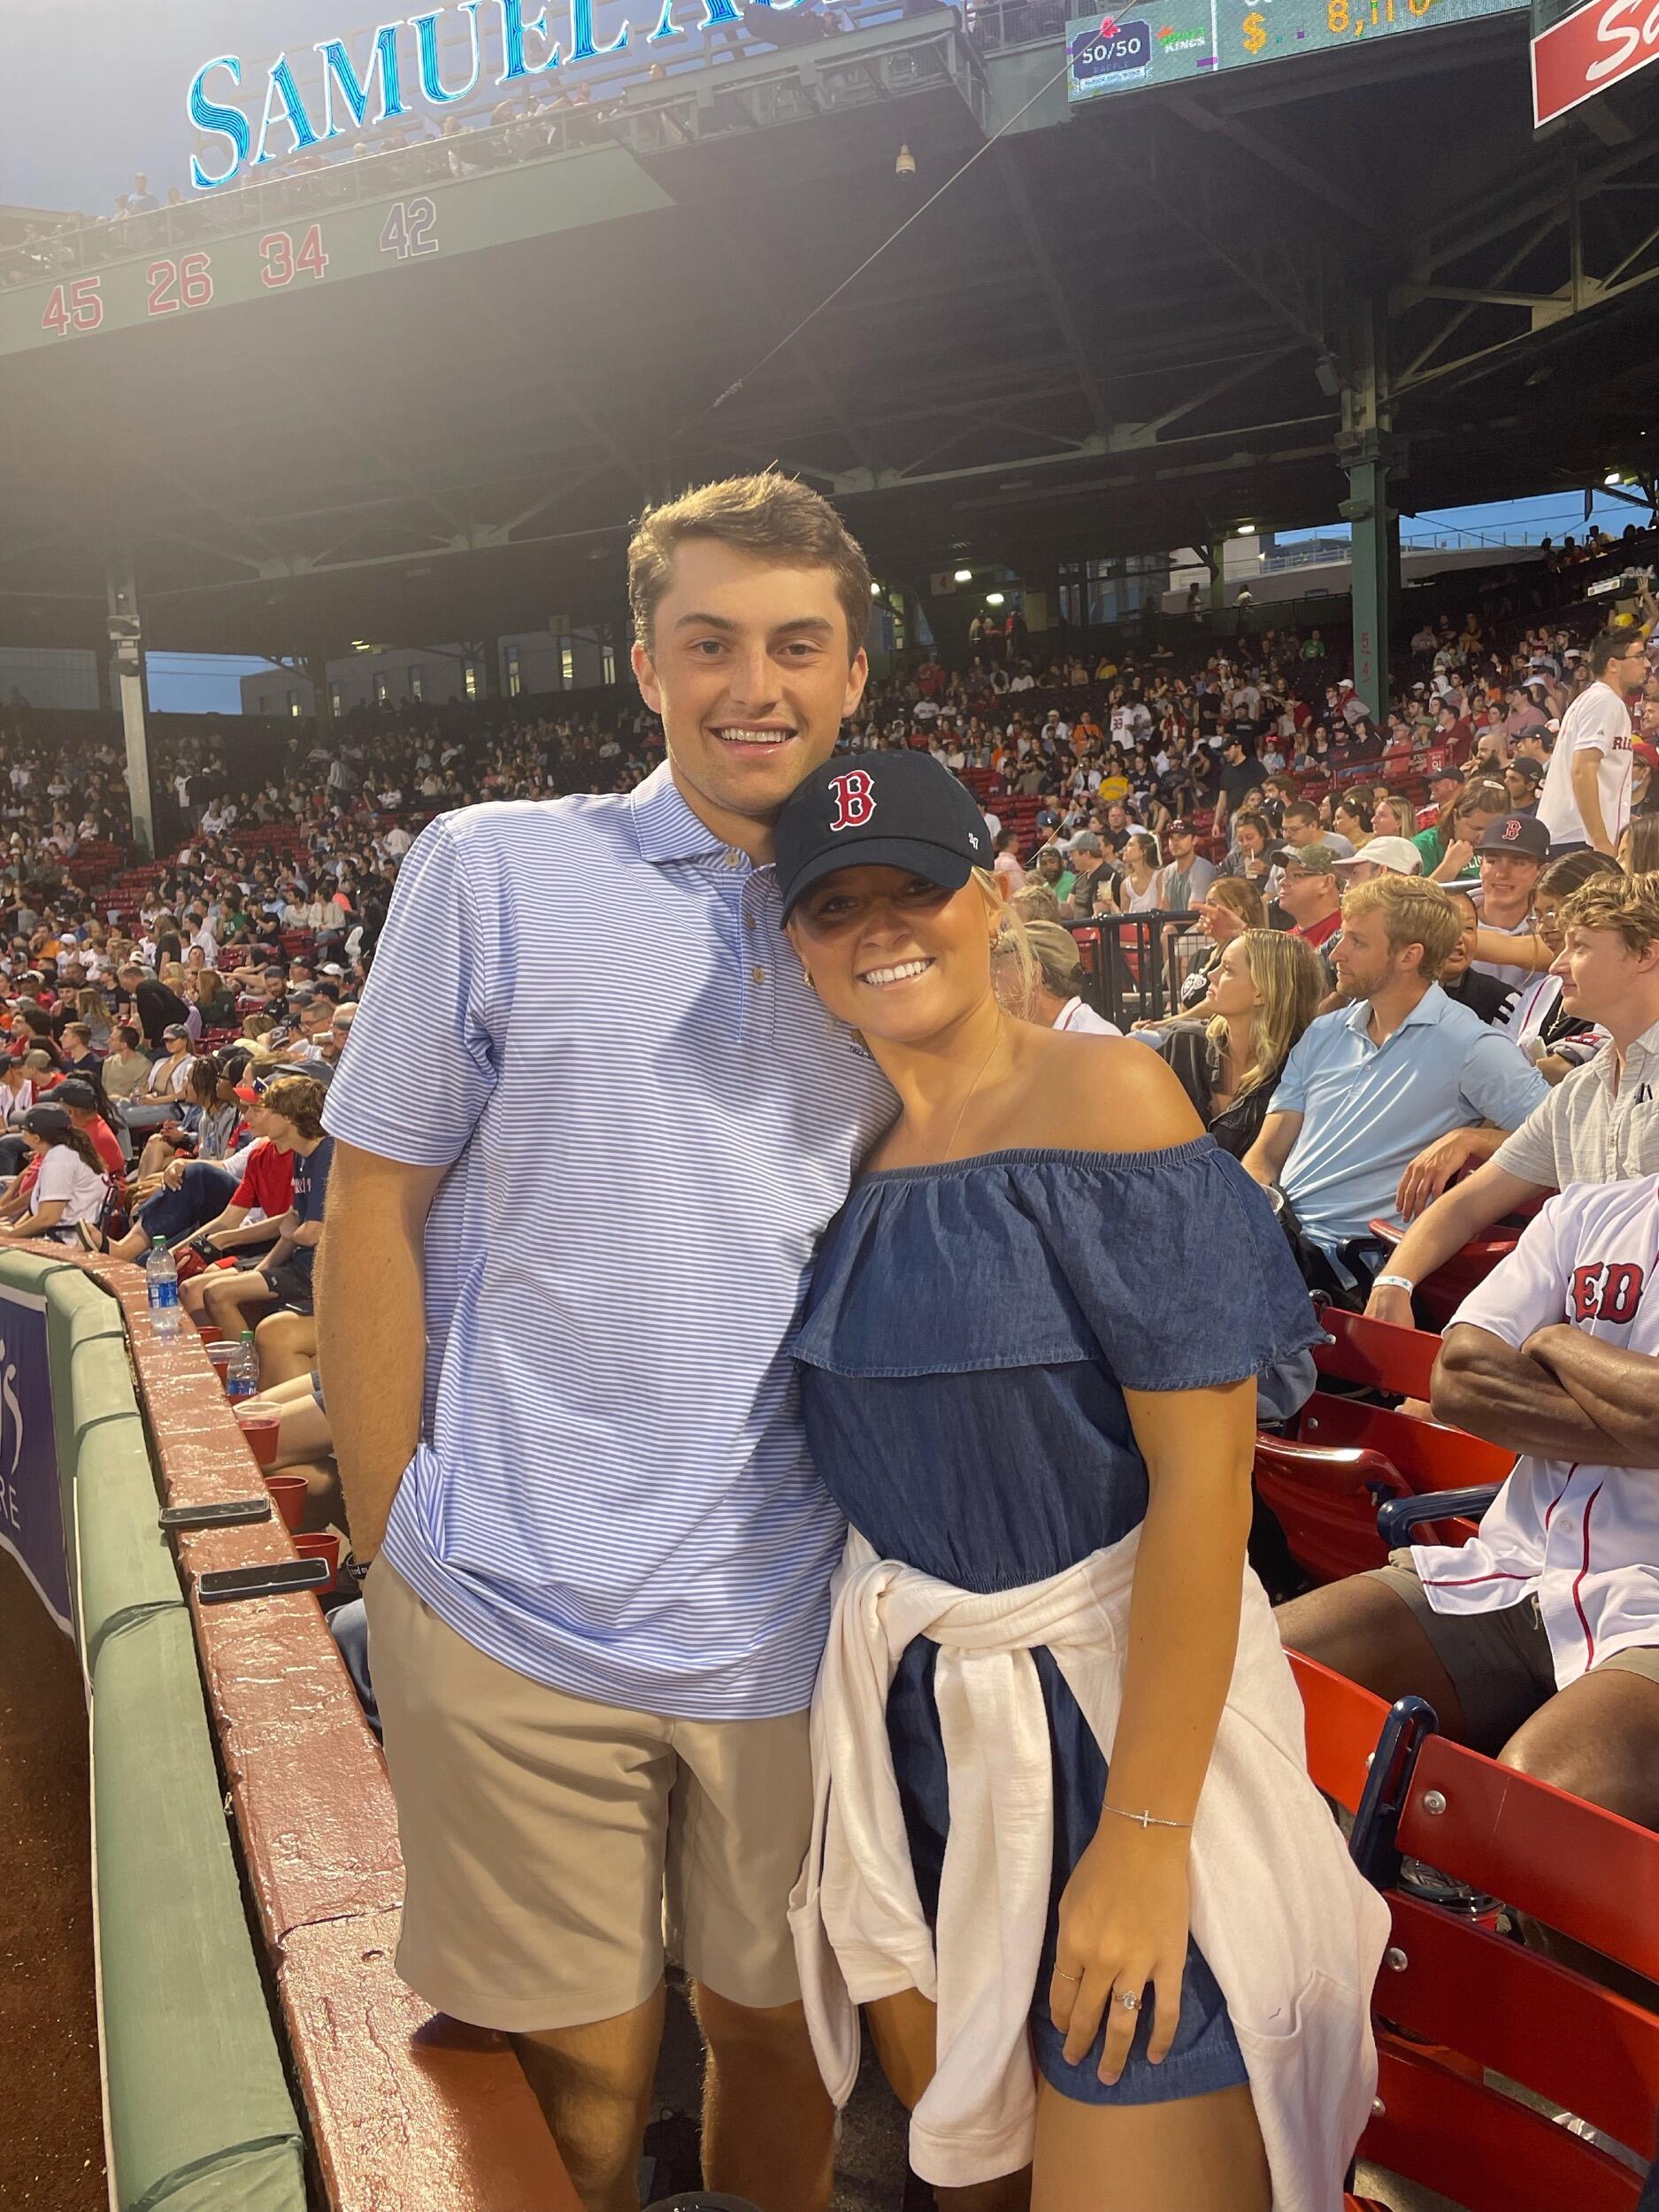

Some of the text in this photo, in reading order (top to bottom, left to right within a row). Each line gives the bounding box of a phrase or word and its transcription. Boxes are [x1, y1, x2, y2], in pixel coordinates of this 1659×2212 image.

[1082, 37, 1142, 65] 50/50
[186, 0, 629, 190] SAMUEL
[259, 224, 330, 288] 34
[380, 196, 439, 259] 42
[42, 276, 104, 336] 45
[146, 251, 214, 316] 26
[828, 769, 877, 832] B
[1502, 819, 1522, 841] B
[1570, 1261, 1645, 1325] ED
